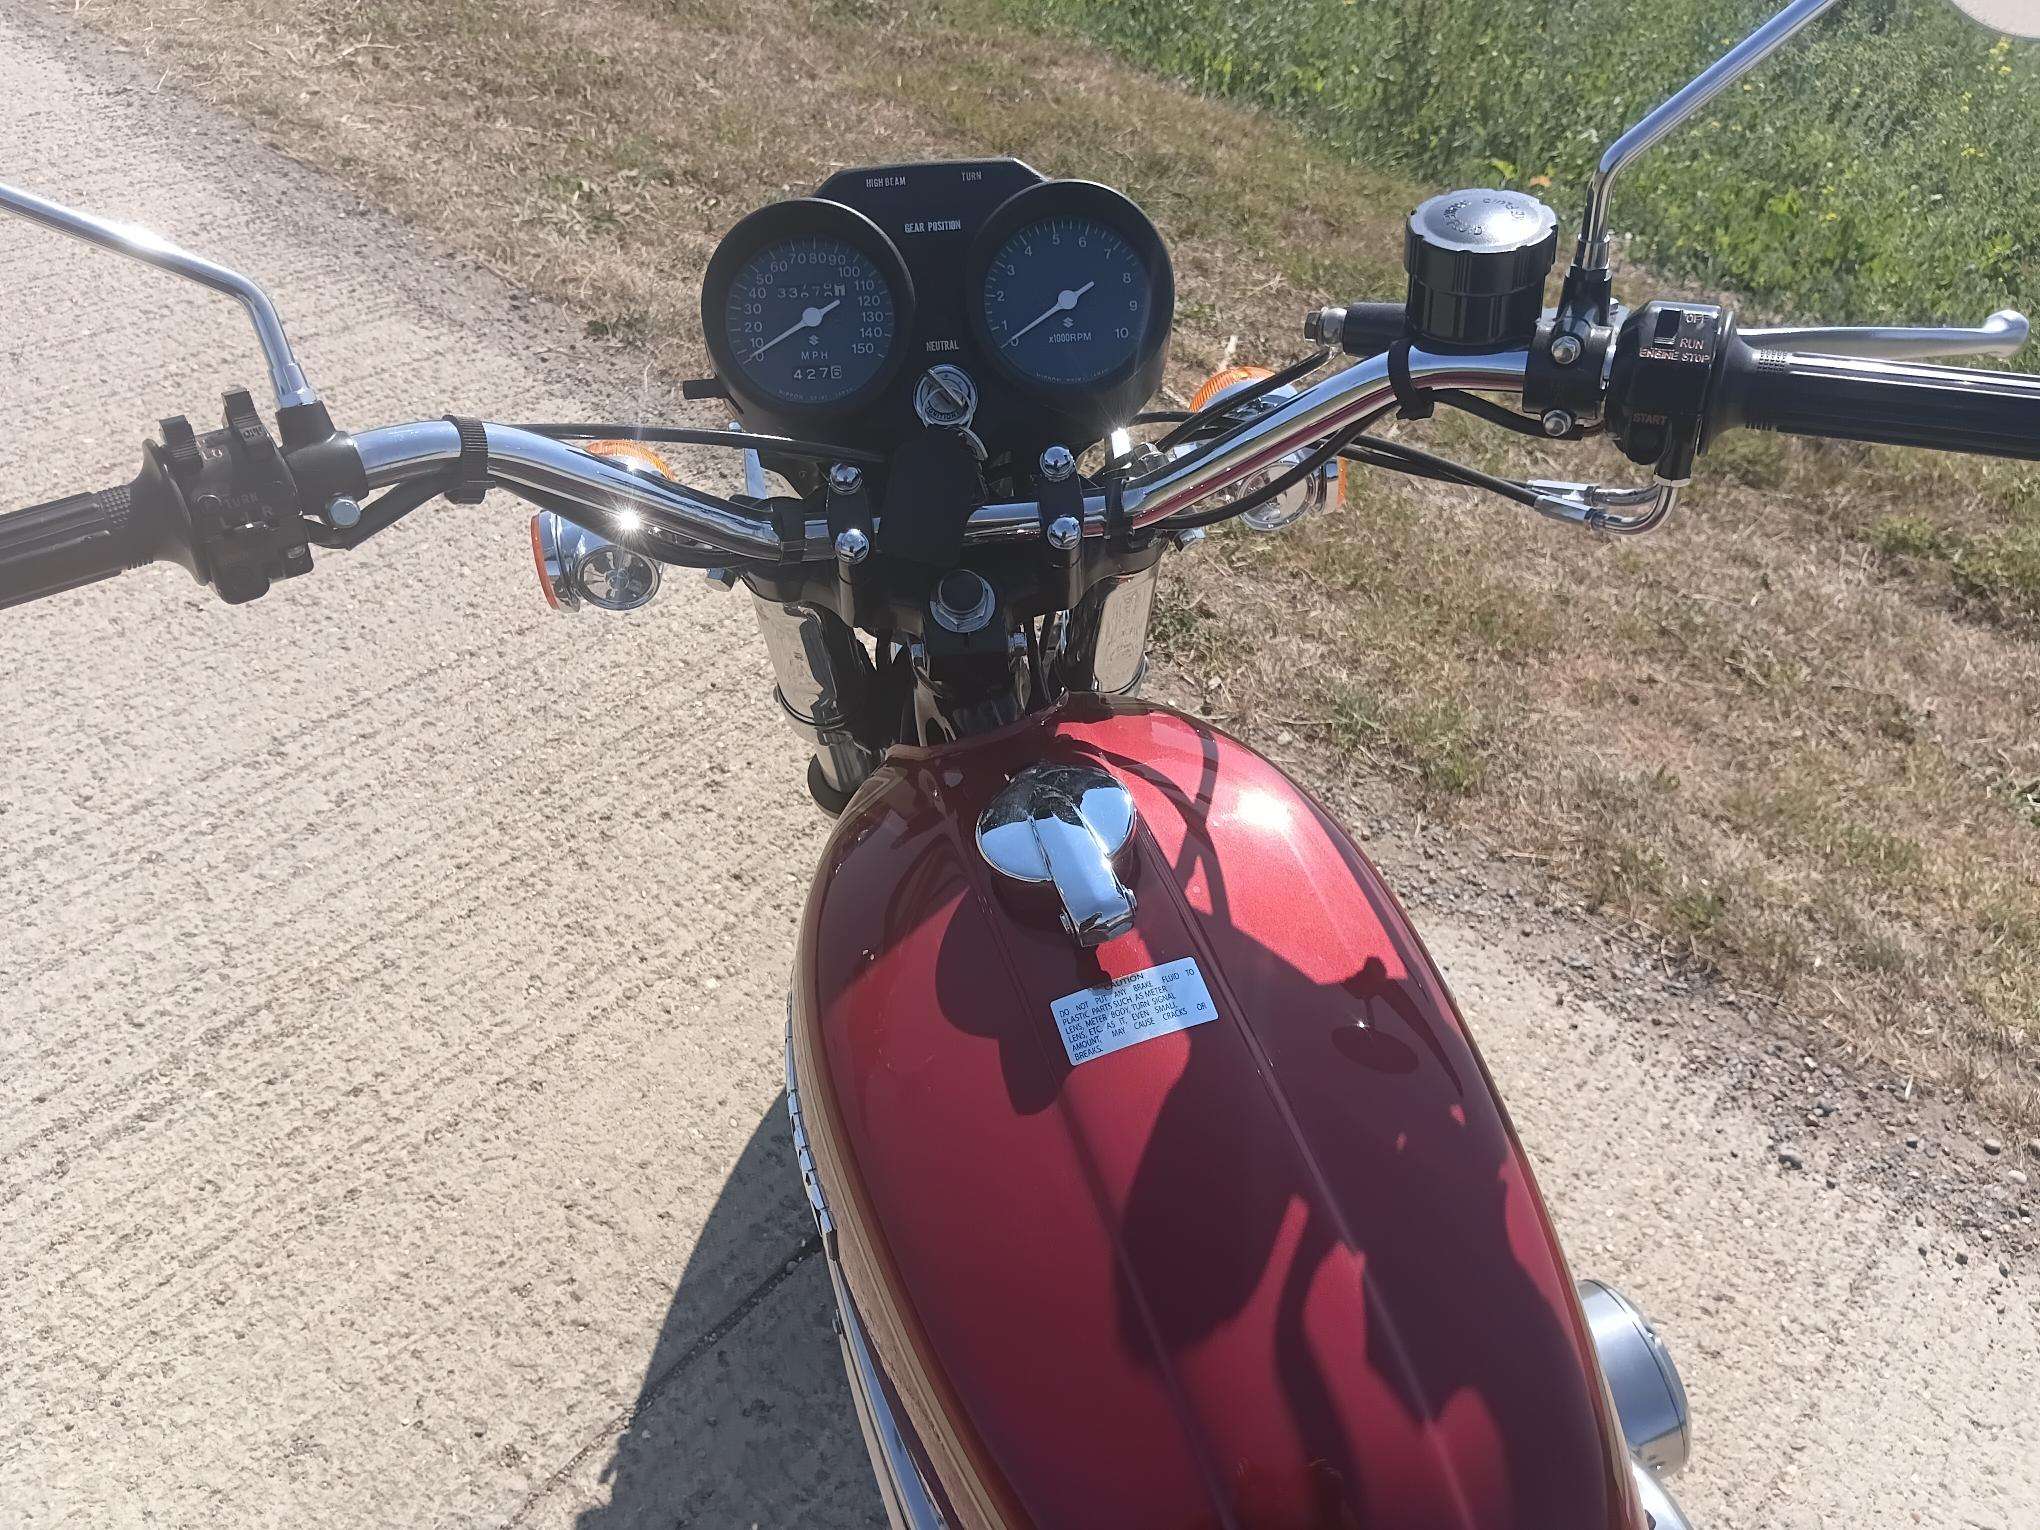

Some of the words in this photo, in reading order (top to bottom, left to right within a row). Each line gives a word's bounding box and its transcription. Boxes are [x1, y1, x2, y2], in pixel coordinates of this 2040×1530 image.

[866, 178, 884, 188] HIGH
[885, 176, 906, 187] BEAM
[961, 171, 982, 182] TURN
[904, 223, 925, 233] GEAR
[927, 219, 961, 232] POSITION
[1052, 233, 1061, 245] 5
[1078, 236, 1087, 248] 6
[1024, 246, 1033, 257] 4
[1104, 249, 1112, 260] 7
[789, 253, 806, 264] 70
[809, 252, 827, 264] 80
[828, 254, 846, 266] 90
[770, 261, 788, 273] 60
[839, 266, 861, 278] 100
[1007, 264, 1016, 276] 3
[756, 274, 773, 285] 50
[1122, 272, 1132, 284] 8
[854, 279, 875, 291] 110
[749, 287, 767, 299] 40
[996, 290, 1005, 302] 2
[858, 295, 880, 307] 120
[1129, 300, 1138, 311] 9
[744, 303, 762, 315] 30
[862, 311, 884, 323] 130
[1685, 313, 1710, 324] OFF
[744, 321, 763, 333] 20
[860, 327, 883, 338] 140
[1115, 327, 1129, 339] 10
[750, 337, 764, 349] 10
[851, 342, 874, 354] 150
[926, 340, 960, 352] NEUTRAL
[1679, 337, 1704, 350] RUN
[1638, 347, 1679, 361] ENGINE
[1680, 352, 1711, 364] STOP
[1632, 413, 1668, 426] START
[1059, 1008, 1070, 1018] DO
[1075, 1002, 1089, 1012] NOT
[1095, 995, 1108, 1005] PUT
[1114, 988, 1127, 998] ANY
[1133, 980, 1153, 991] BRAKE
[1161, 972, 1180, 983] FLUID
[1184, 969, 1195, 977] TO
[1062, 1011, 1090, 1025] PLASTIC
[1091, 1003, 1113, 1016] PARTS
[1113, 996, 1133, 1008] SUCH
[1135, 993, 1145, 1001] AS
[1144, 985, 1168, 998] METER
[1085, 1014, 1108, 1028] METER
[1131, 999, 1151, 1012] TURN
[1152, 993, 1177, 1005] SIGNAL
[1106, 1020, 1116, 1030] AS
[1131, 1009, 1150, 1021] EVEN
[1155, 1002, 1178, 1014] SMALL
[1111, 1027, 1126, 1038] MAY
[1134, 1018, 1156, 1030] CAUSE
[1162, 1007, 1188, 1021] CRACKS
[1196, 1002, 1208, 1012] OR
